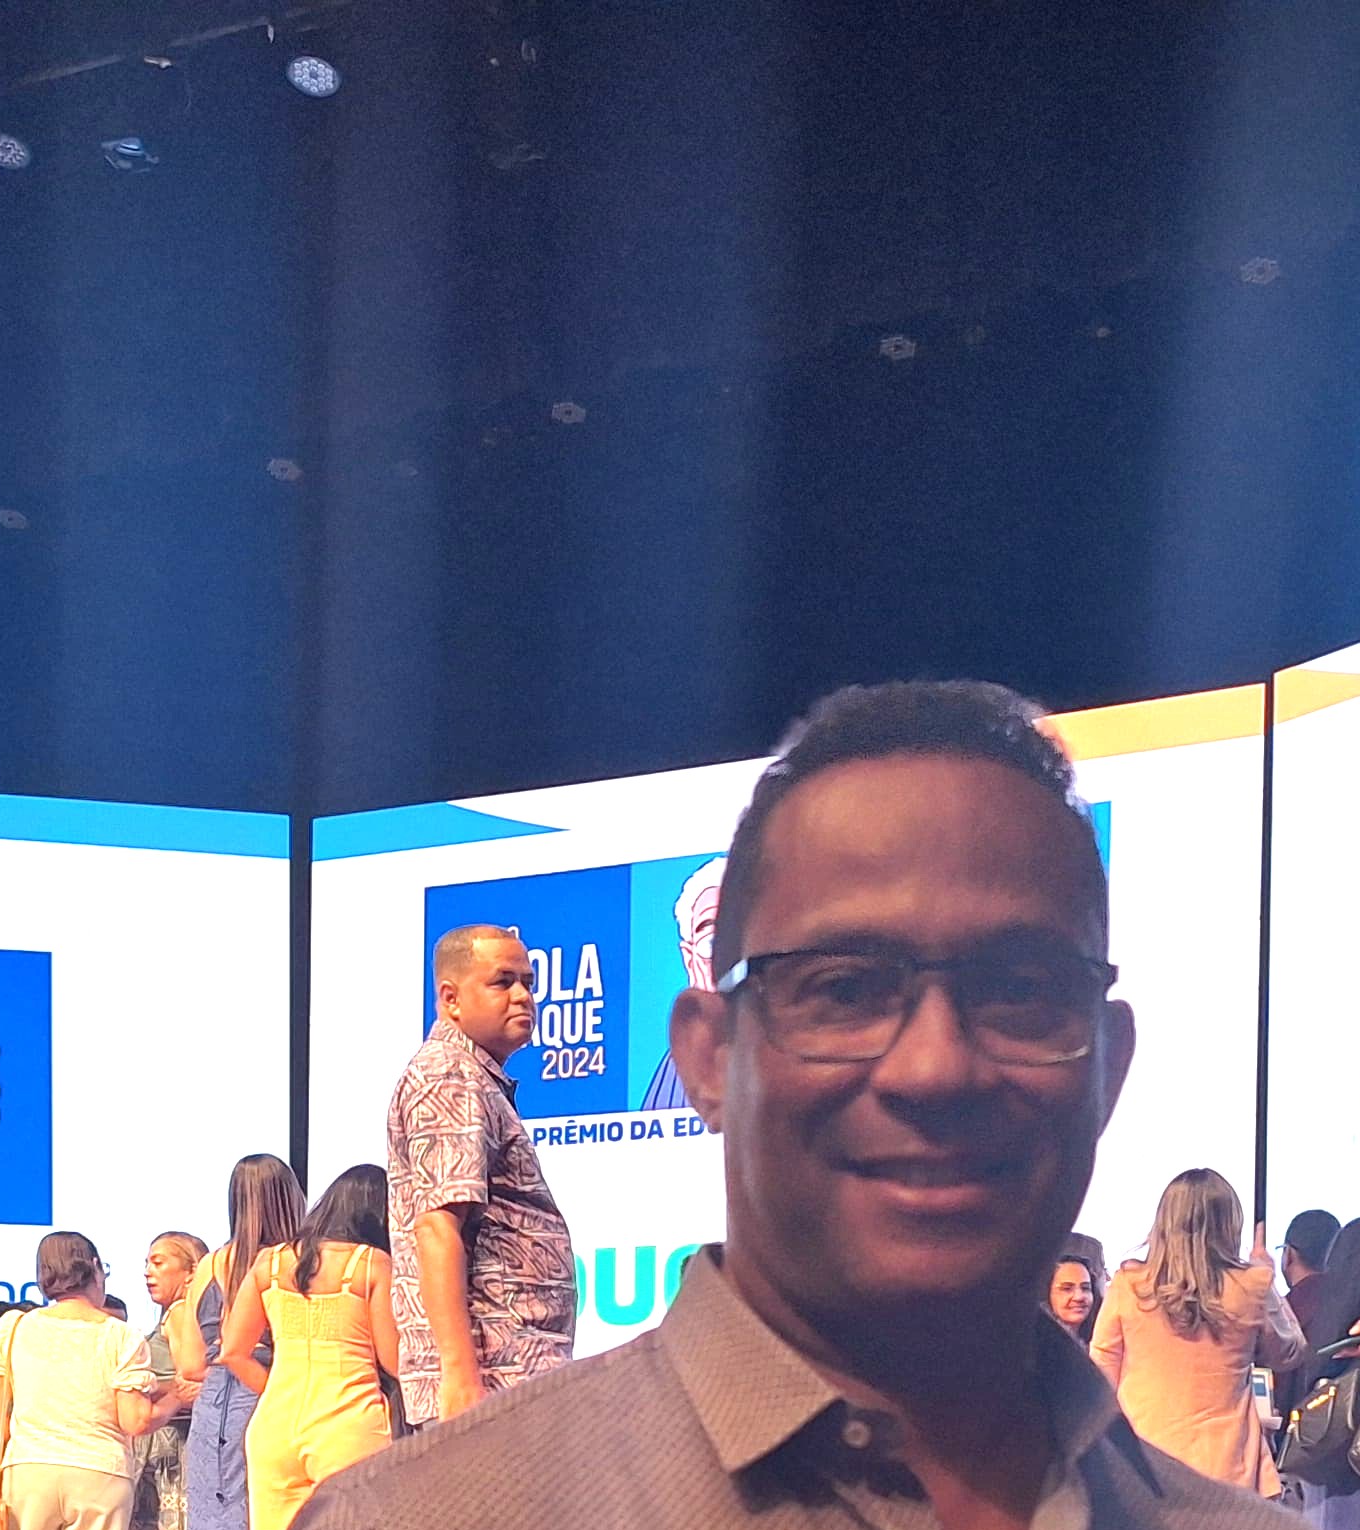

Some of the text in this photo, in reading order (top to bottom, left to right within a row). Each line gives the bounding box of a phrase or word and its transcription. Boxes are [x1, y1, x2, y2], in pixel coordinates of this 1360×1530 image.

[541, 1046, 606, 1081] 2024
[532, 1119, 624, 1147] PRÊMIO
[630, 1118, 665, 1140] DA
